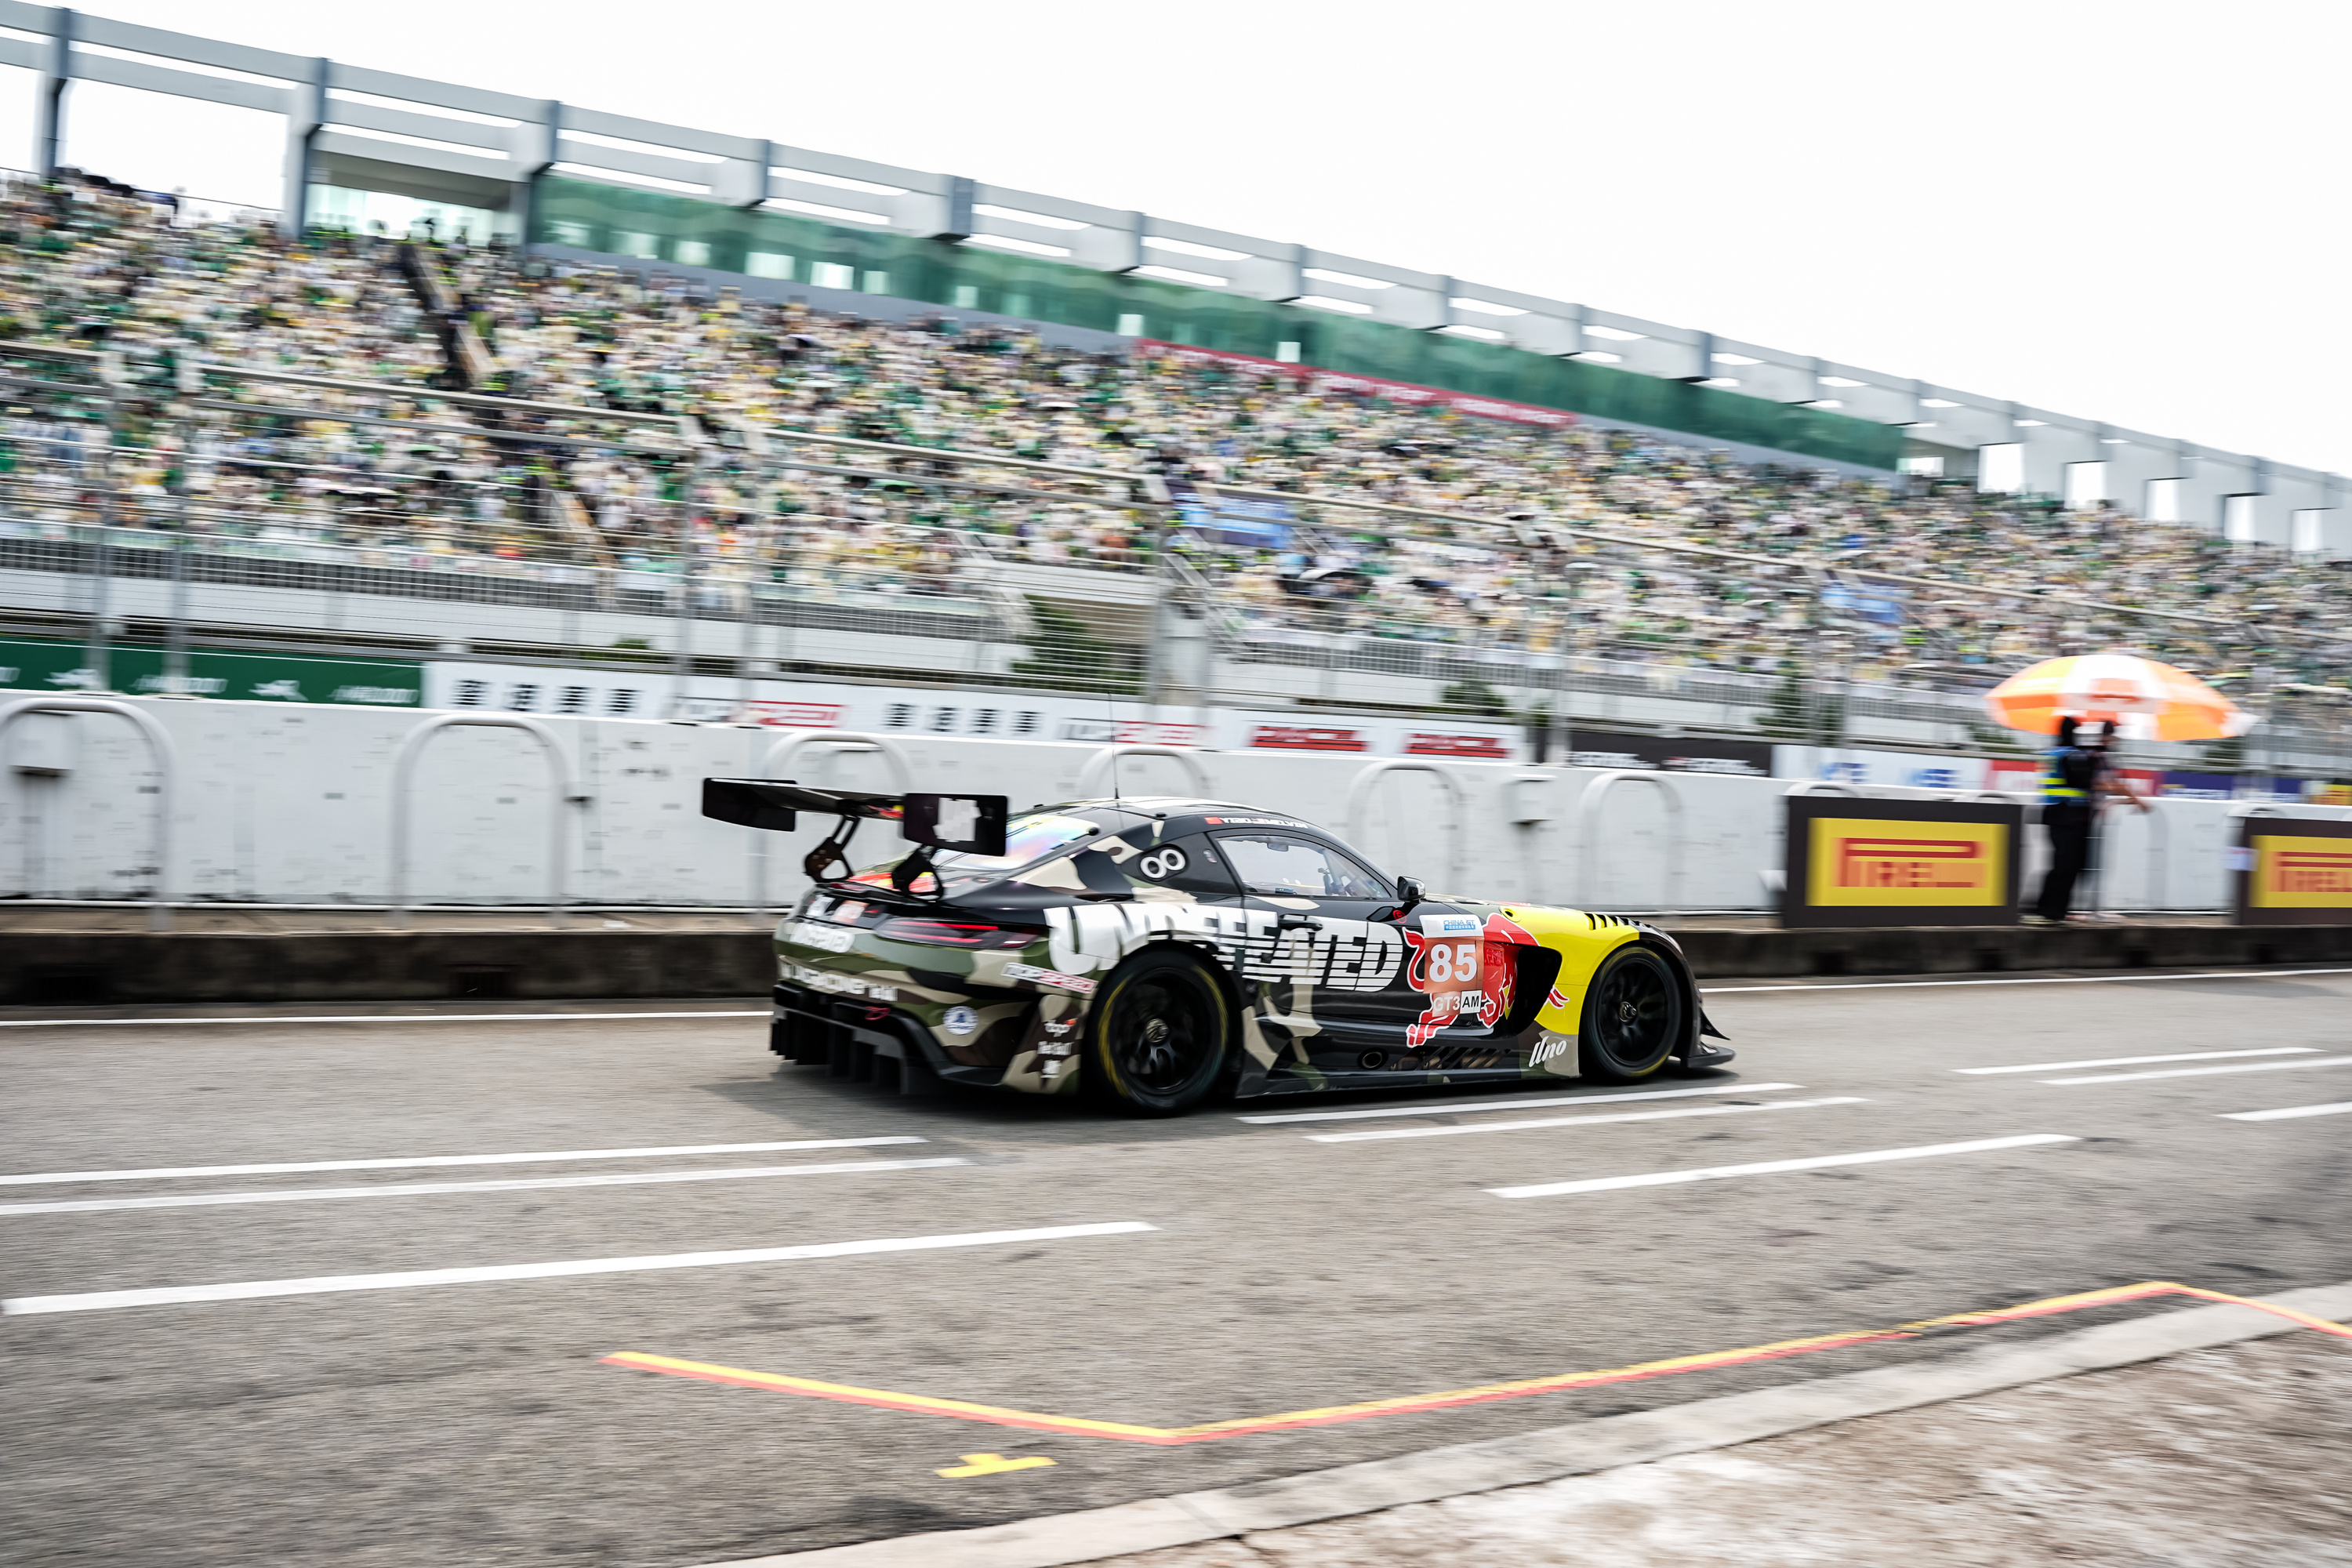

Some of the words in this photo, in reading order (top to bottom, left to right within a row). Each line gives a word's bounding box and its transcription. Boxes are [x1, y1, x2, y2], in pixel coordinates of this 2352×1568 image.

[1428, 943, 1478, 983] 85
[1433, 993, 1461, 1012] GT3
[1461, 995, 1480, 1009] AM
